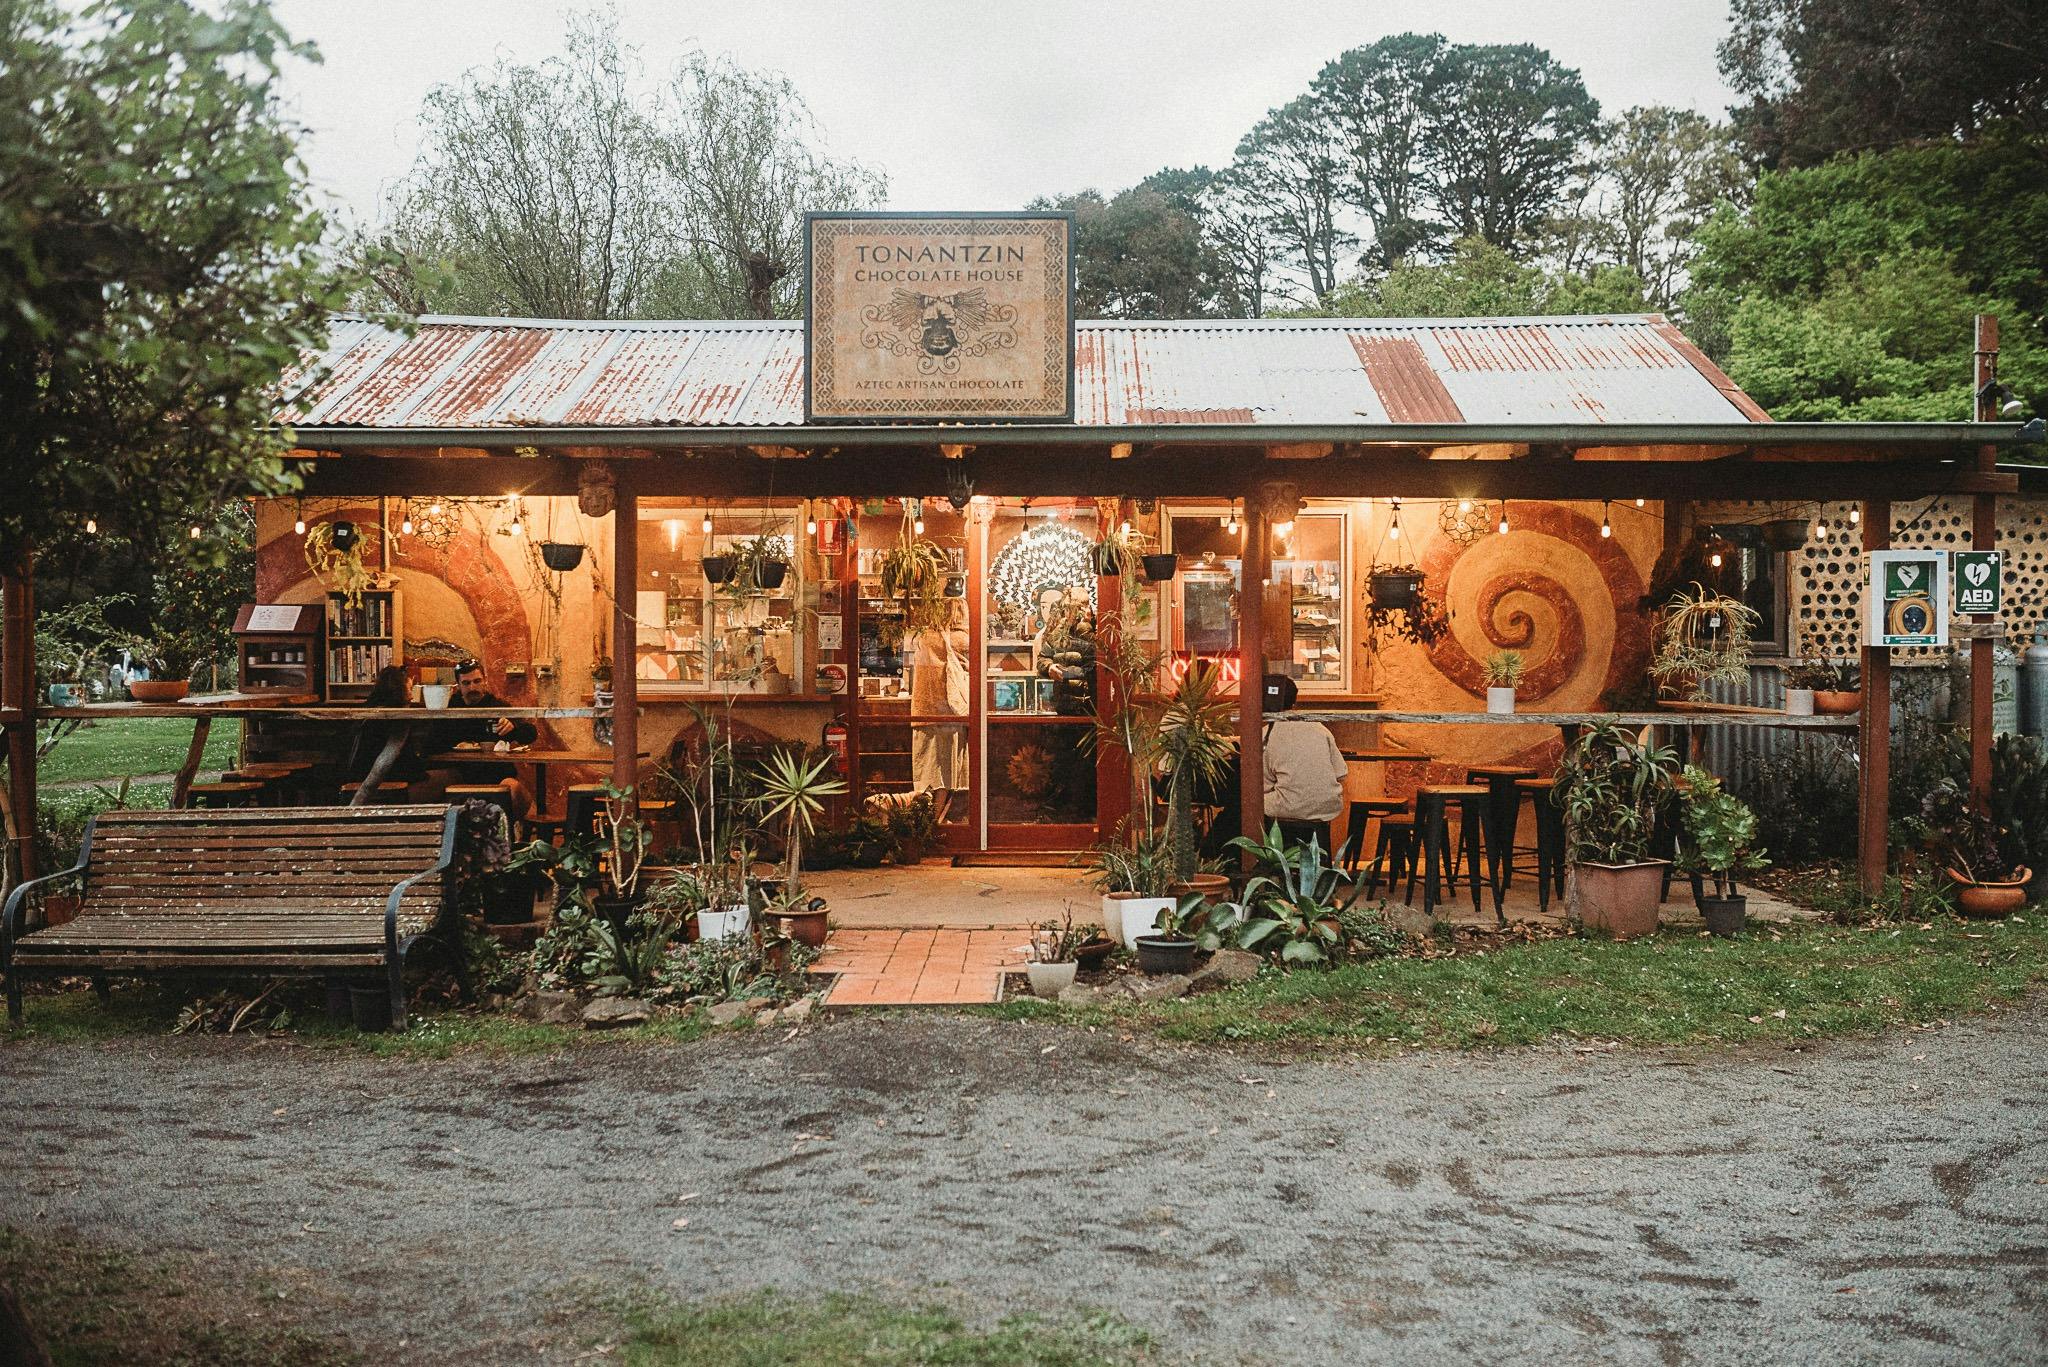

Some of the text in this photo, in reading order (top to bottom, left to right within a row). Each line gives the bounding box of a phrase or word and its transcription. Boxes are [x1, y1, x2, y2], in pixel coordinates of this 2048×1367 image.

[855, 245, 1024, 263] TONANTZIN
[854, 269, 1024, 282] CHOCOLATE HOUSE
[855, 380, 1024, 390] AZTEC ARTISAN CHOCOLATE
[1960, 589, 1994, 603] AED
[1171, 657, 1240, 681] ON
